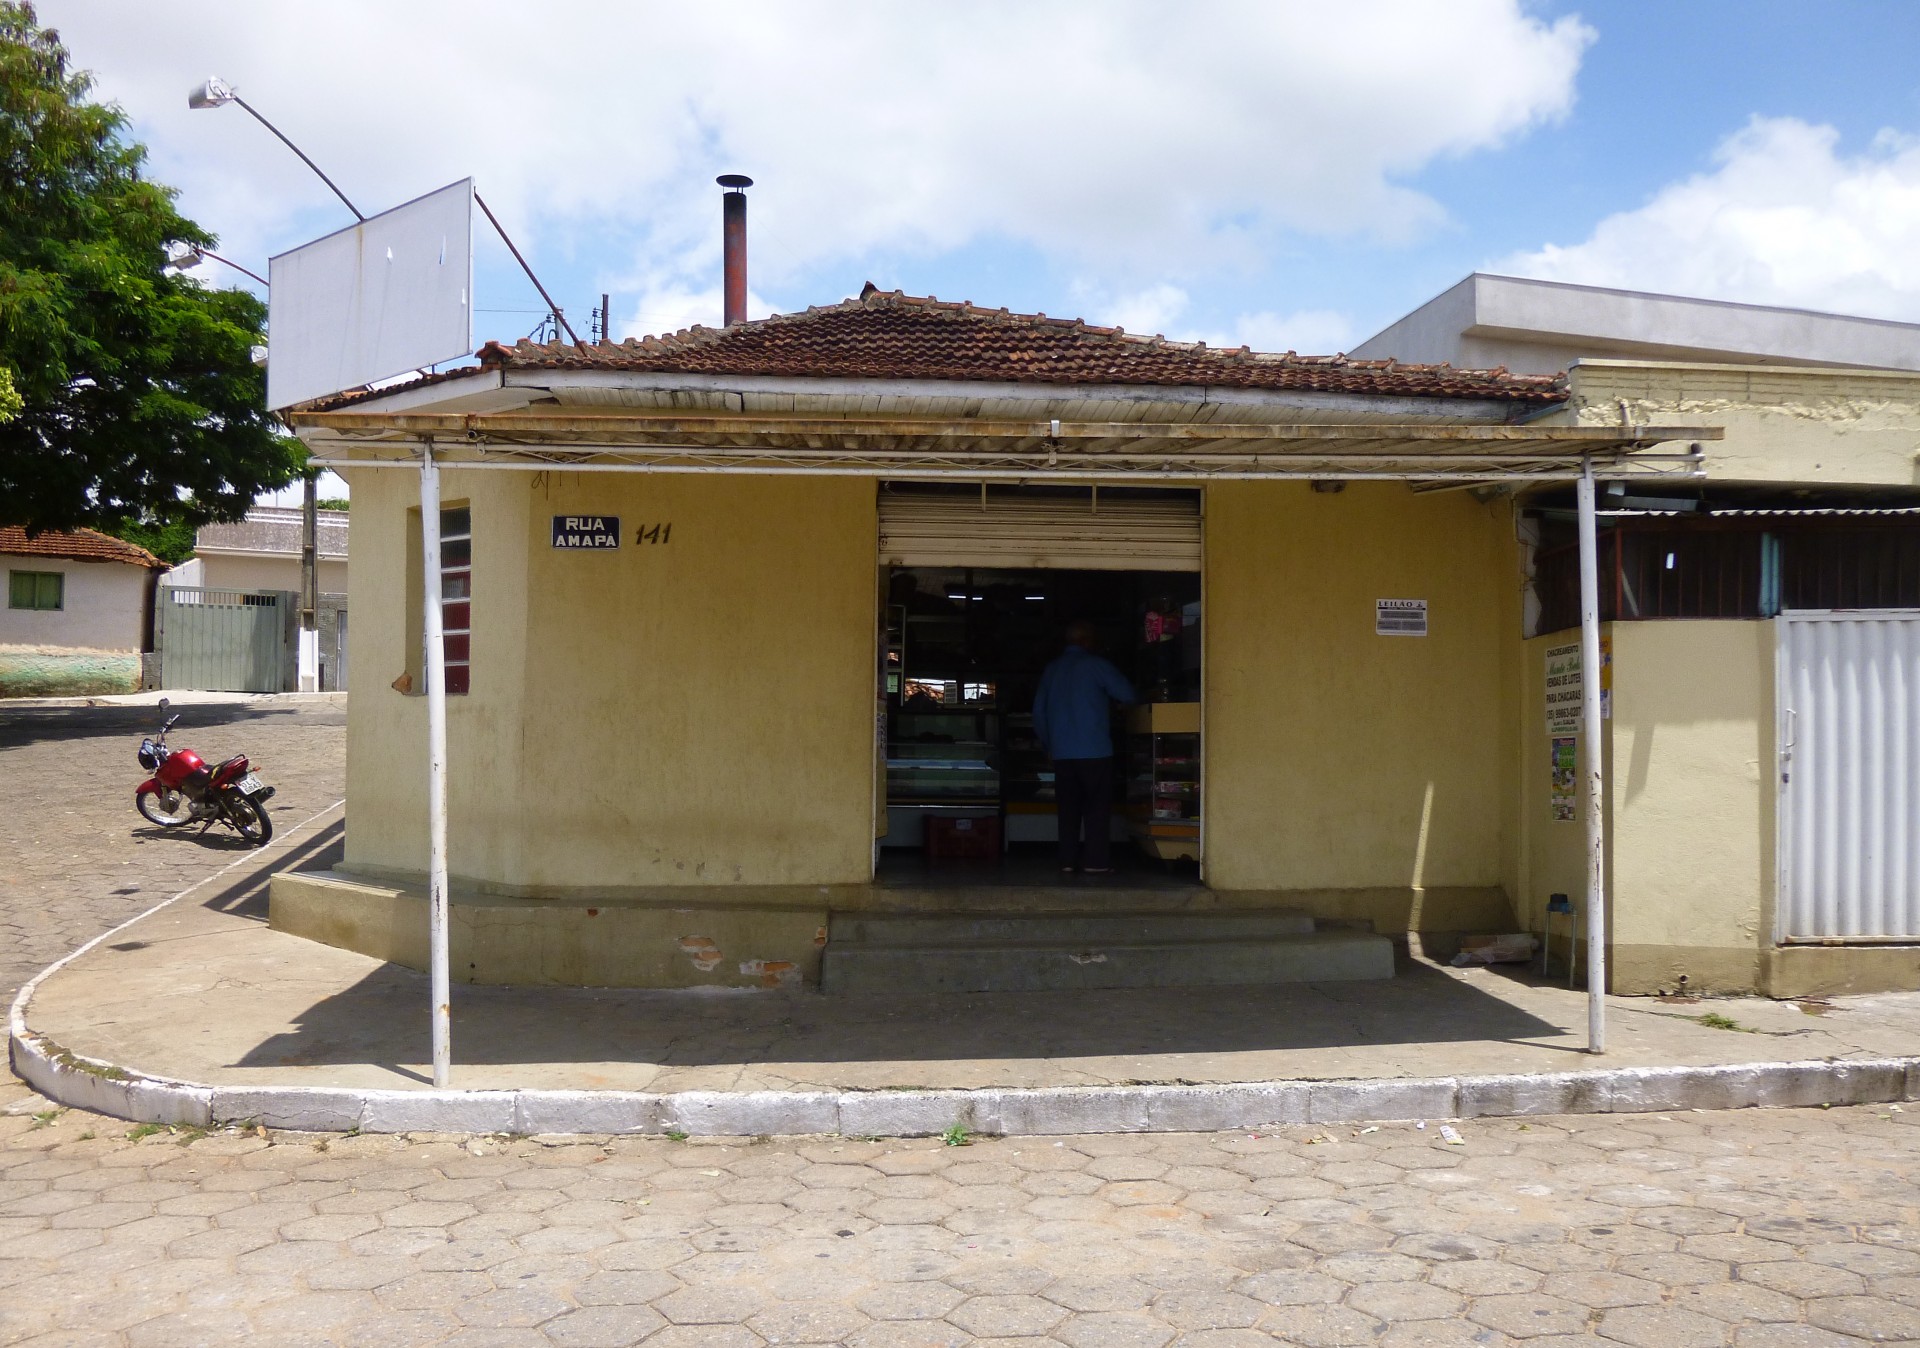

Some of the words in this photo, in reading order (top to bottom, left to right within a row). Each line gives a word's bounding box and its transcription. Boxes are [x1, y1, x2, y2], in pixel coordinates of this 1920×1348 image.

[566, 518, 605, 531] RUA
[636, 522, 671, 545] 141
[1547, 676, 1561, 688] VENDAS
[1562, 675, 1568, 686] DE
[1568, 673, 1581, 685] LOTES
[1547, 692, 1557, 703] PARA
